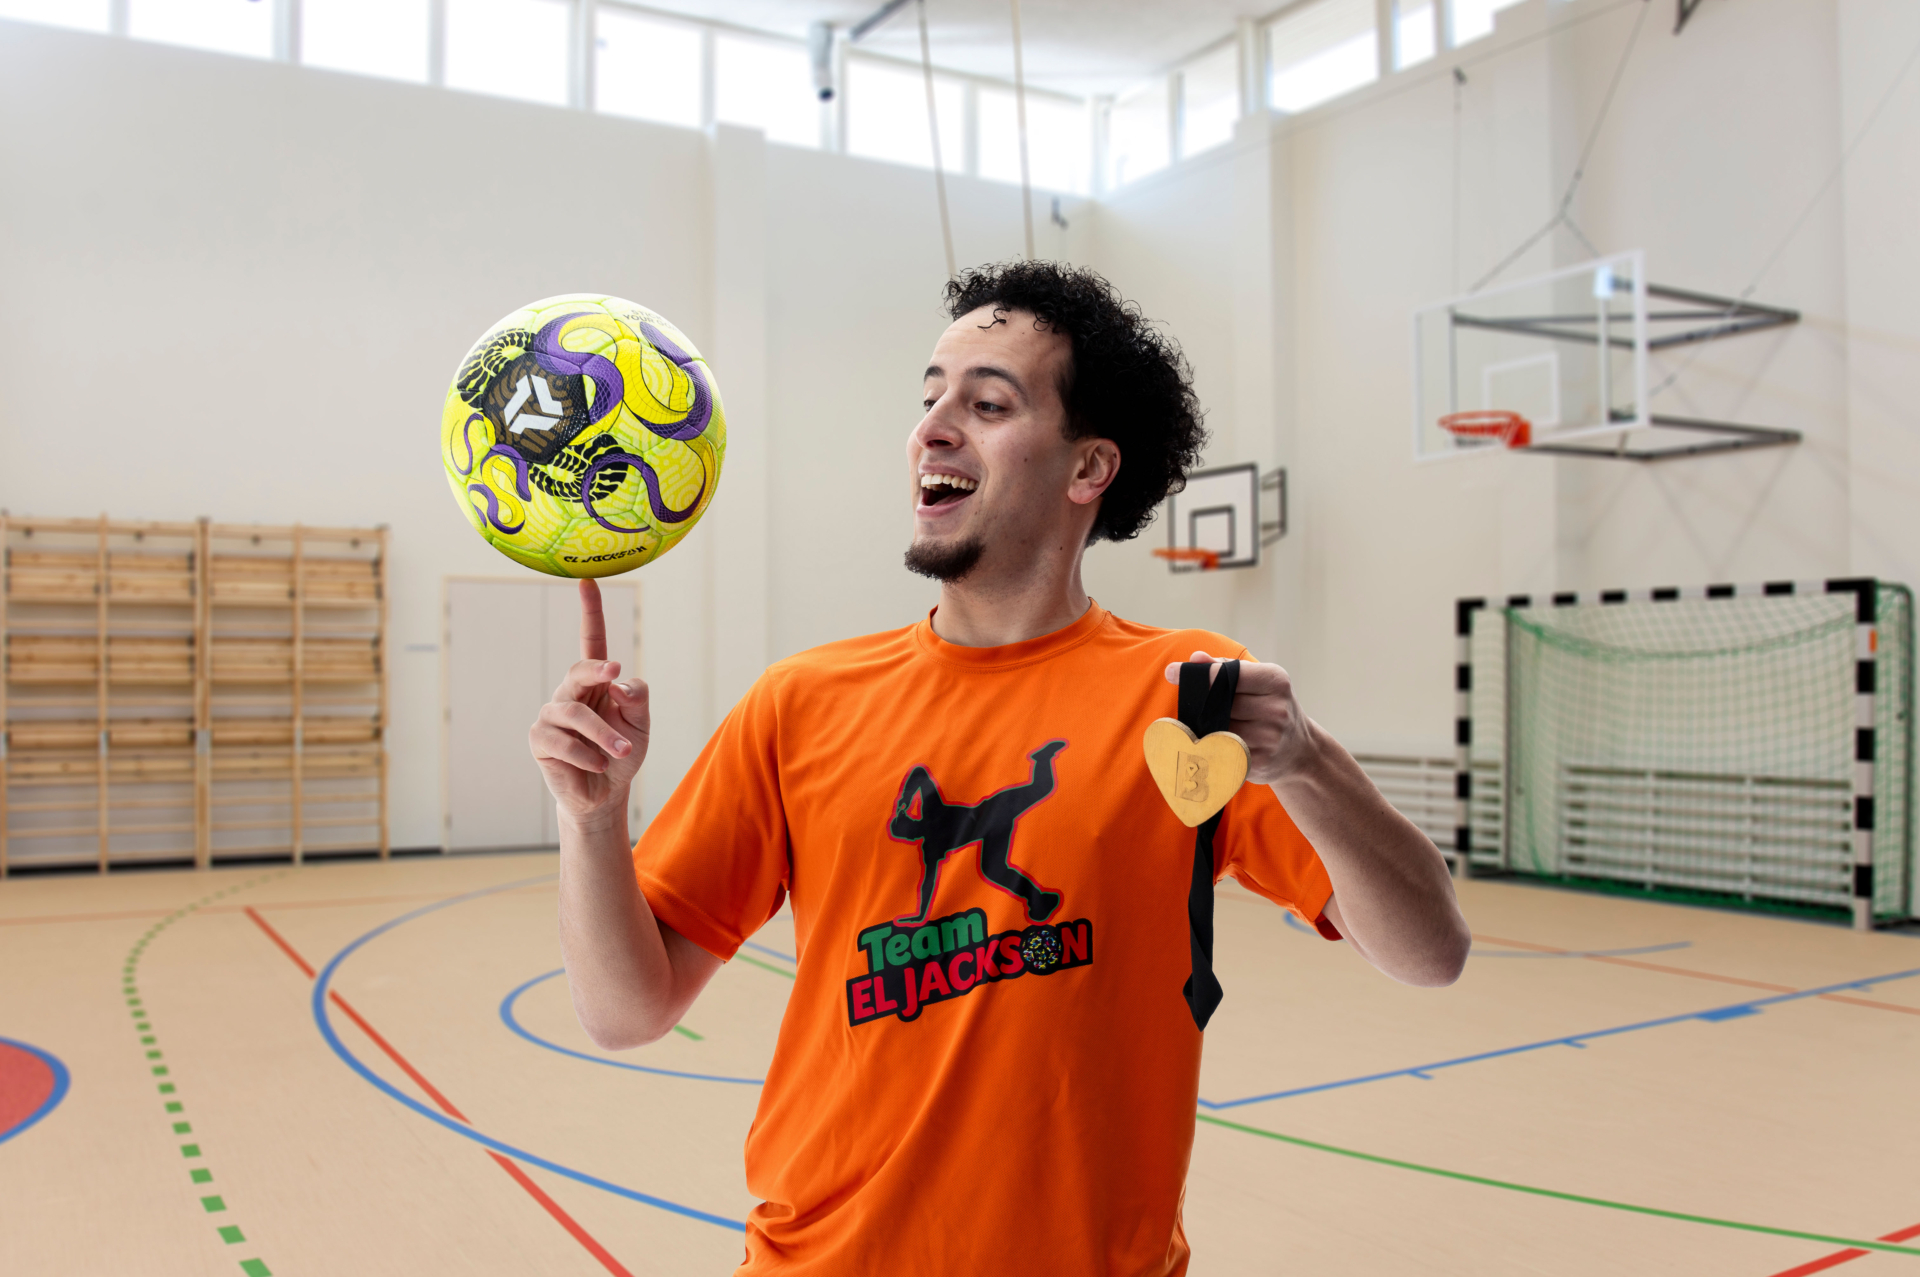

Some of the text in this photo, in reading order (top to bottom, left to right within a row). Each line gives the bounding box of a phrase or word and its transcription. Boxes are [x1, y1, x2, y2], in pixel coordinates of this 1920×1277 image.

[622, 314, 654, 323] YOUR
[851, 923, 1088, 1021] EL JACKSON
[861, 912, 984, 973] Team
